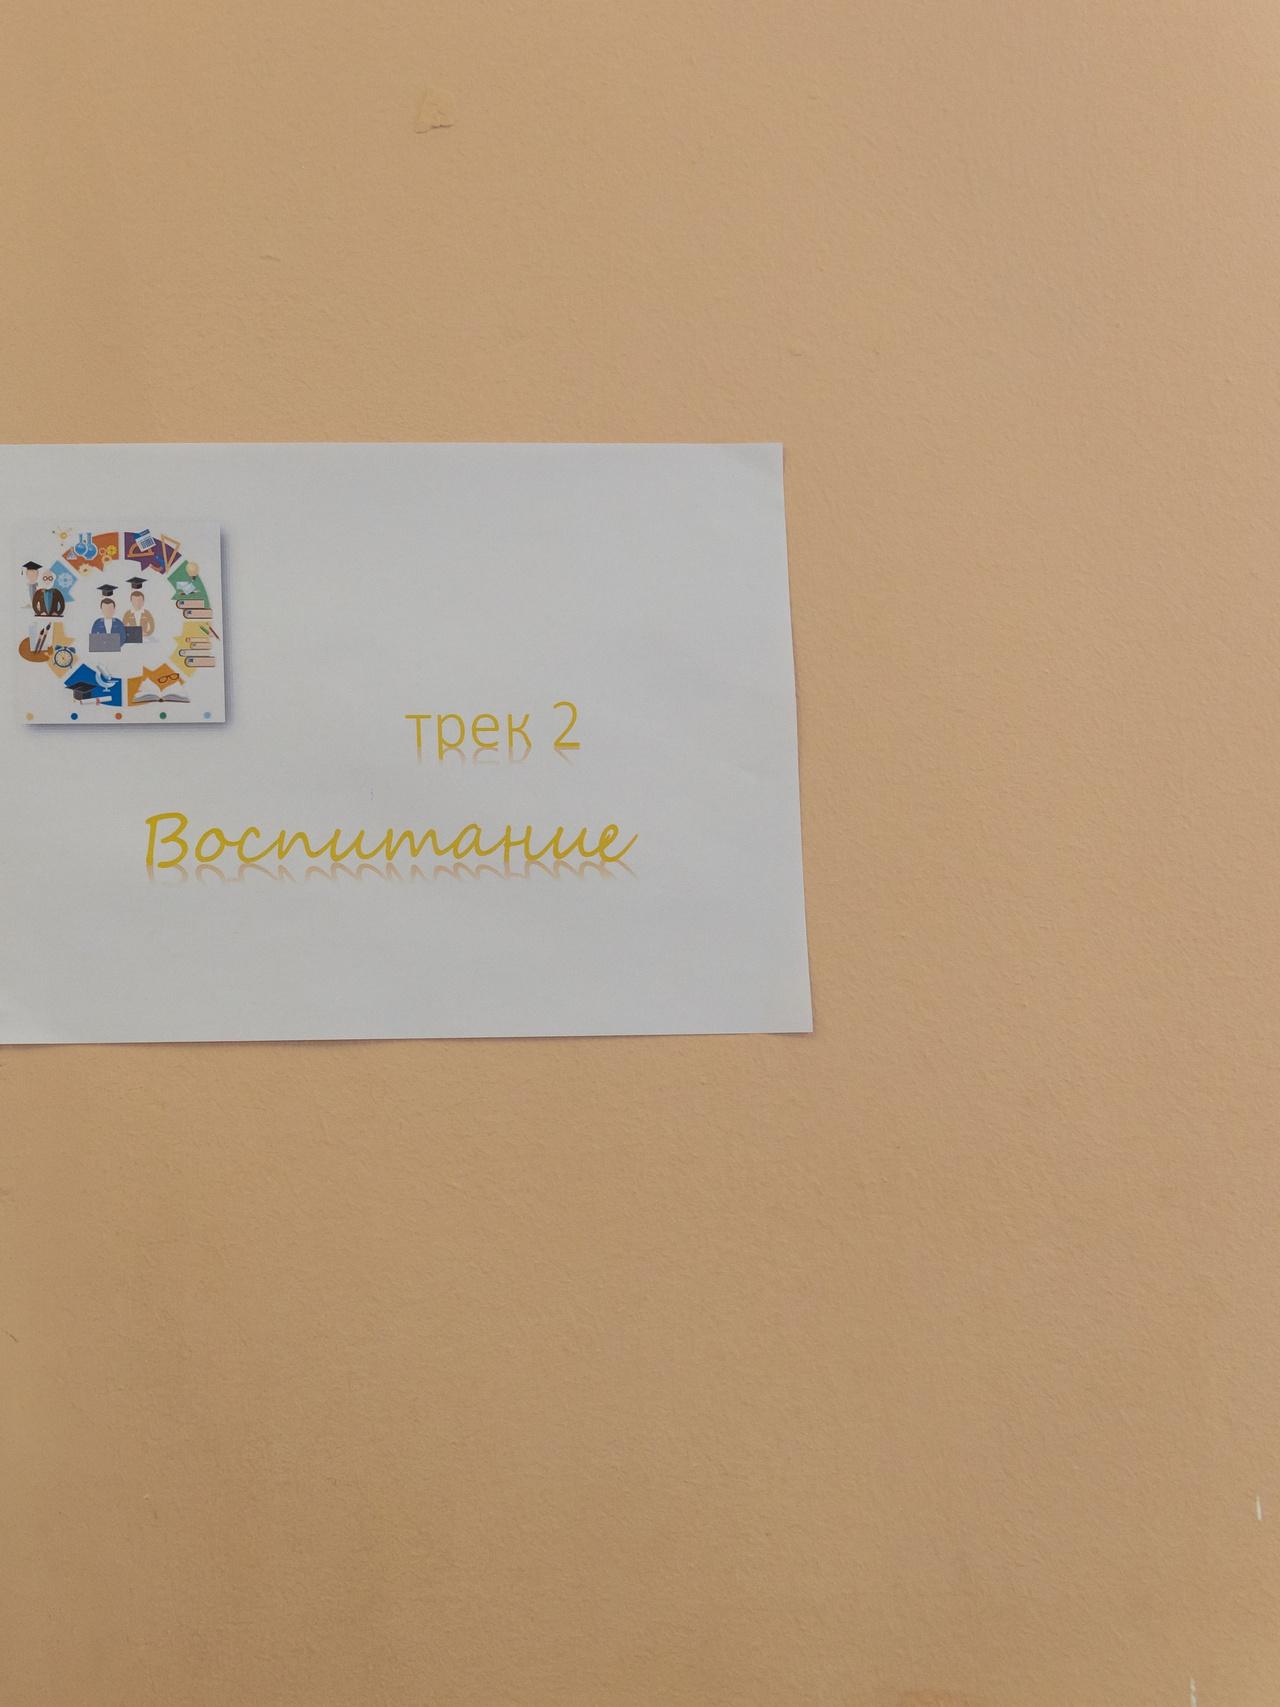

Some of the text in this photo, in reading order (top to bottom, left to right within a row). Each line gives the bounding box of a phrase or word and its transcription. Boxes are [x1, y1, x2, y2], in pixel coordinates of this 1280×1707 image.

[405, 701, 581, 760] трек 2
[145, 812, 639, 869] Воспитание
